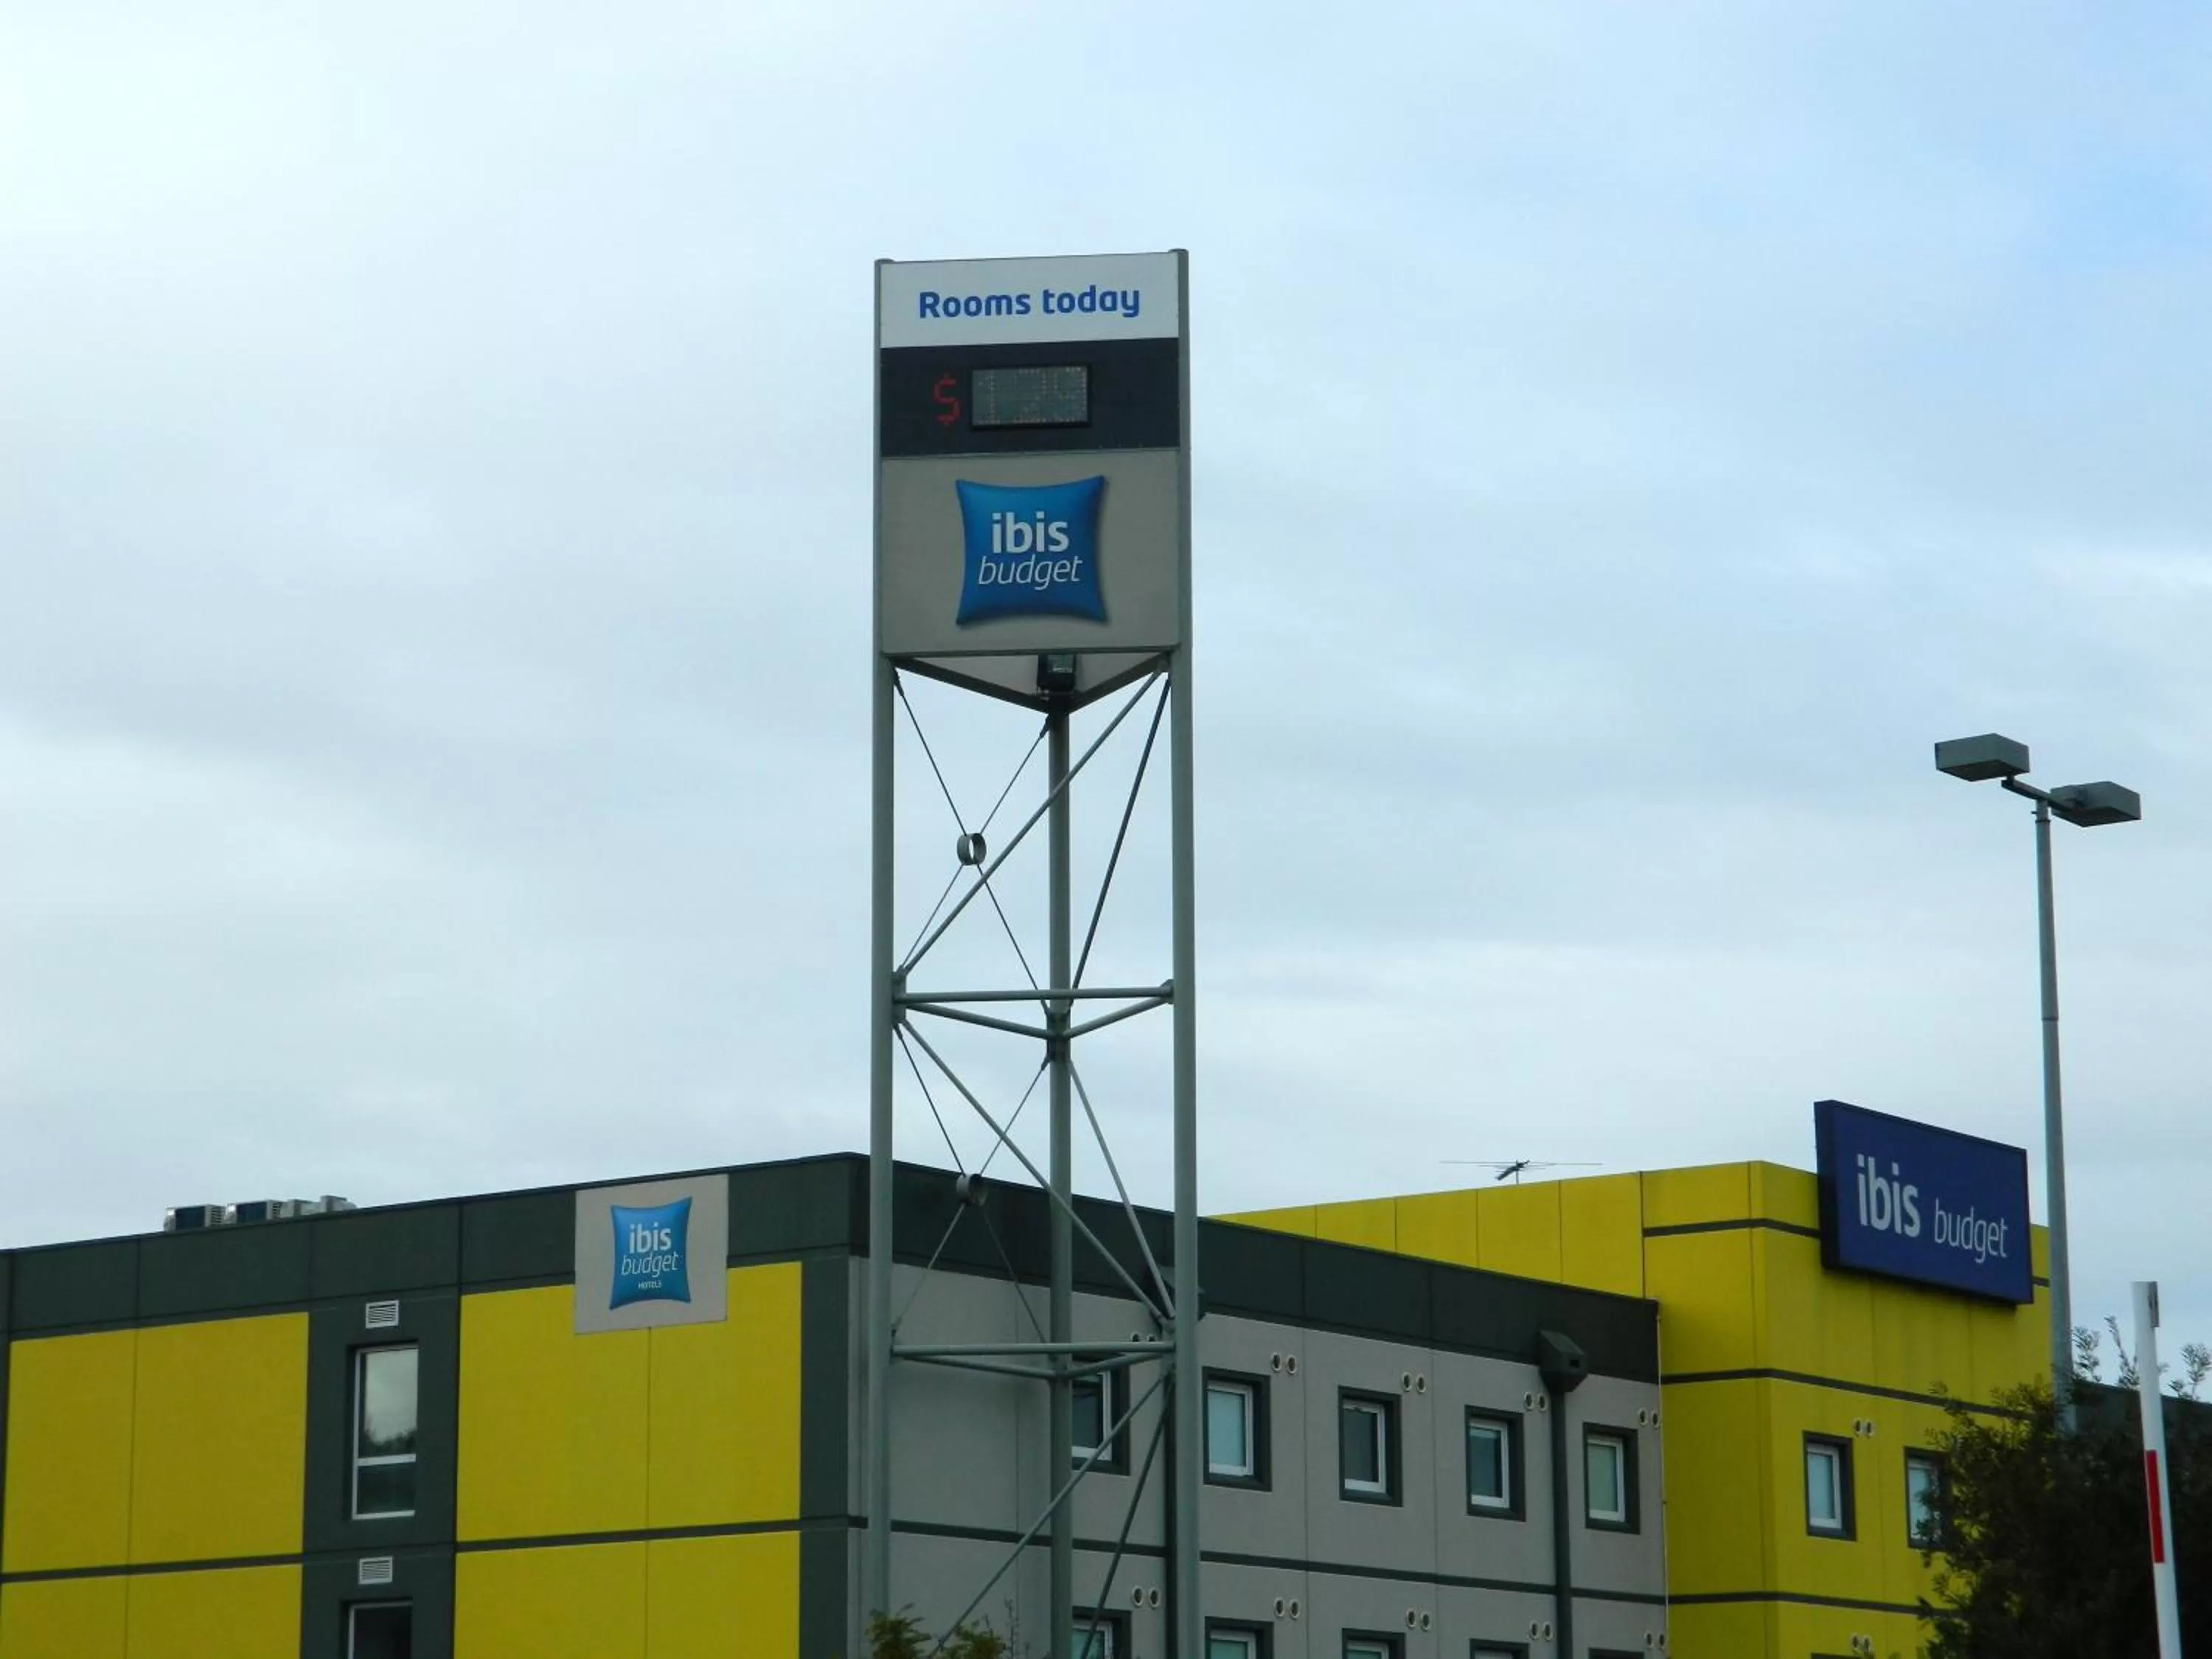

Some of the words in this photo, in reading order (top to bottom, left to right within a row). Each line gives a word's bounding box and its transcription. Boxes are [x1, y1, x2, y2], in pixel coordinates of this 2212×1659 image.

[919, 291, 1031, 319] Rooms
[1043, 285, 1140, 318] today
[992, 511, 1069, 553] ibis
[978, 554, 1083, 591] budget
[1857, 1153, 1921, 1238] ibis
[1934, 1197, 2008, 1264] budget
[629, 1221, 672, 1253] ibis
[621, 1251, 679, 1278] budget
